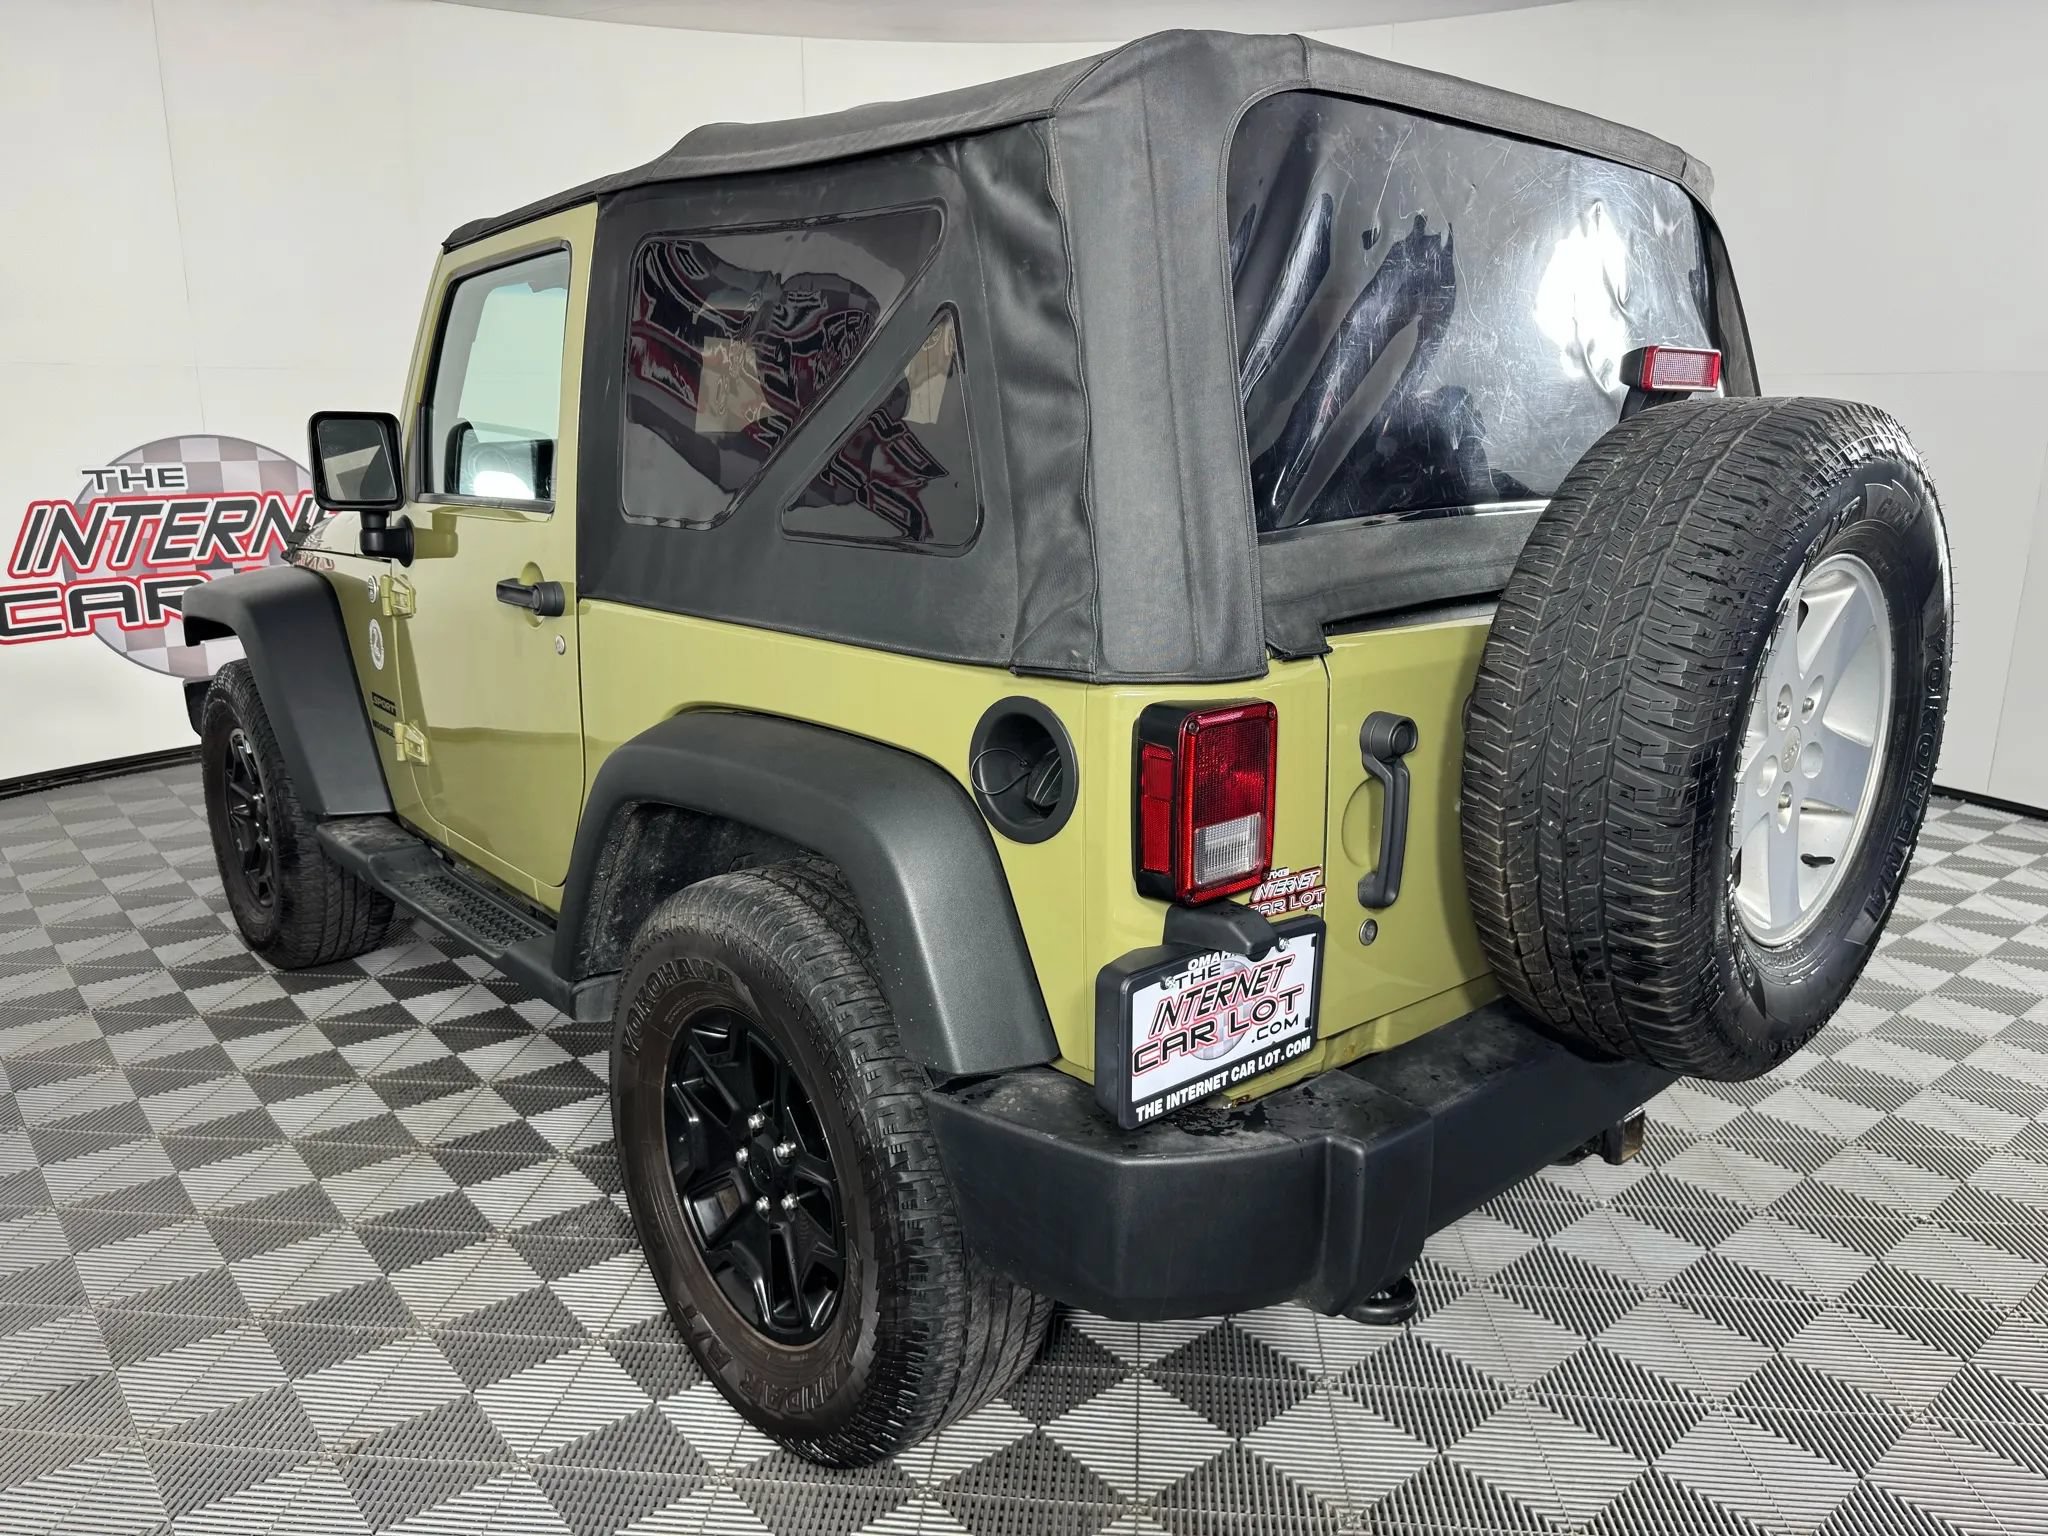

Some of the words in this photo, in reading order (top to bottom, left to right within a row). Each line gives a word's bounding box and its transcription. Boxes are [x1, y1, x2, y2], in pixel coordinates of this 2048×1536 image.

[81, 466, 186, 491] THE
[1253, 869, 1321, 902] INTERNET
[1290, 887, 1326, 911] LOT
[1172, 962, 1221, 990] THE
[1187, 951, 1235, 971] OMAH
[1149, 956, 1294, 1037] INTERNET
[1133, 1020, 1217, 1074] CAR
[1229, 986, 1304, 1032] LOT
[1250, 1013, 1299, 1044] .COM
[1135, 1098, 1164, 1123] THE
[1166, 1070, 1229, 1111] INTERNET
[1230, 1059, 1256, 1086] CAR
